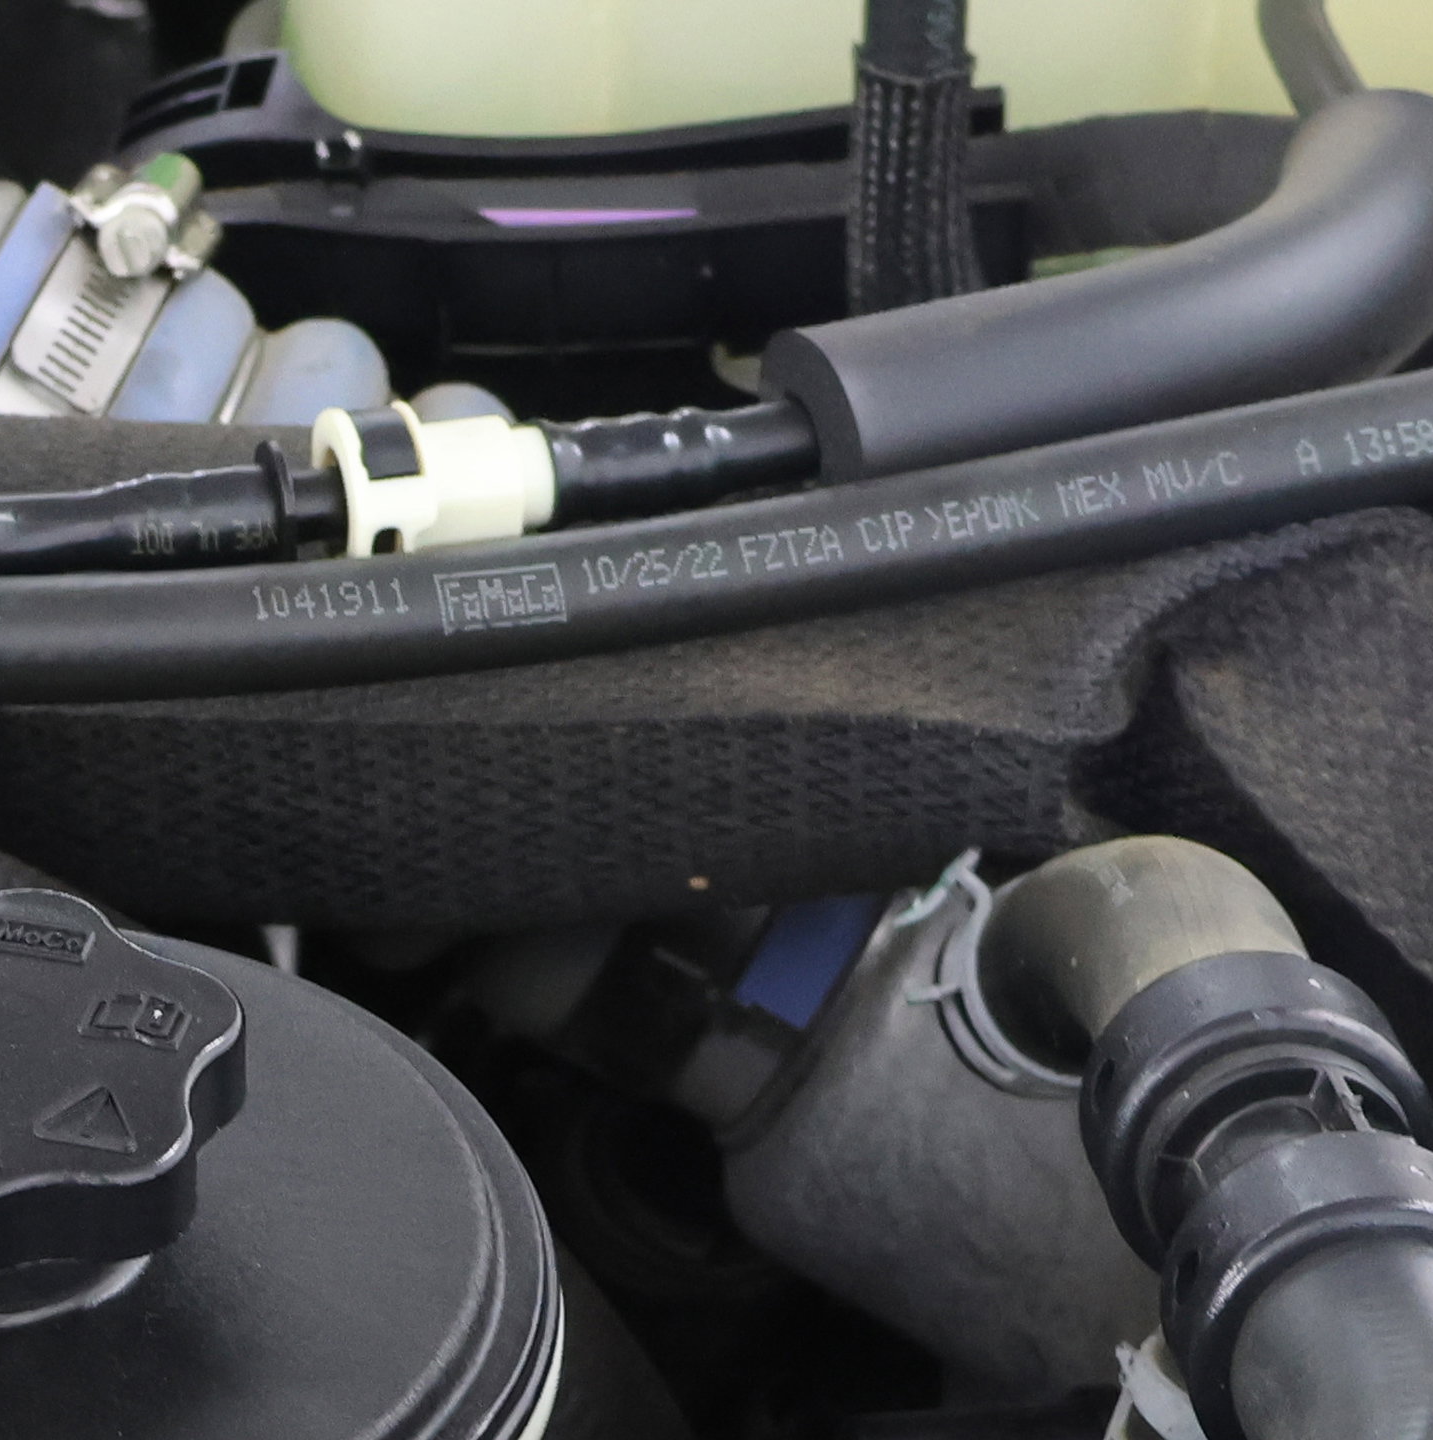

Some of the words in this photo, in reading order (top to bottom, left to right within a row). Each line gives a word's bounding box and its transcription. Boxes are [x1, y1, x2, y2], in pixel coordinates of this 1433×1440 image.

[131, 520, 175, 555] DOT
[231, 519, 278, 551] YPE
[252, 577, 409, 620] 1041911
[444, 574, 560, 623] FoMoCo
[582, 543, 726, 595] 10/25/22
[858, 510, 916, 555] CIP
[1056, 471, 1128, 518] MEX
[1297, 440, 1322, 474] A
